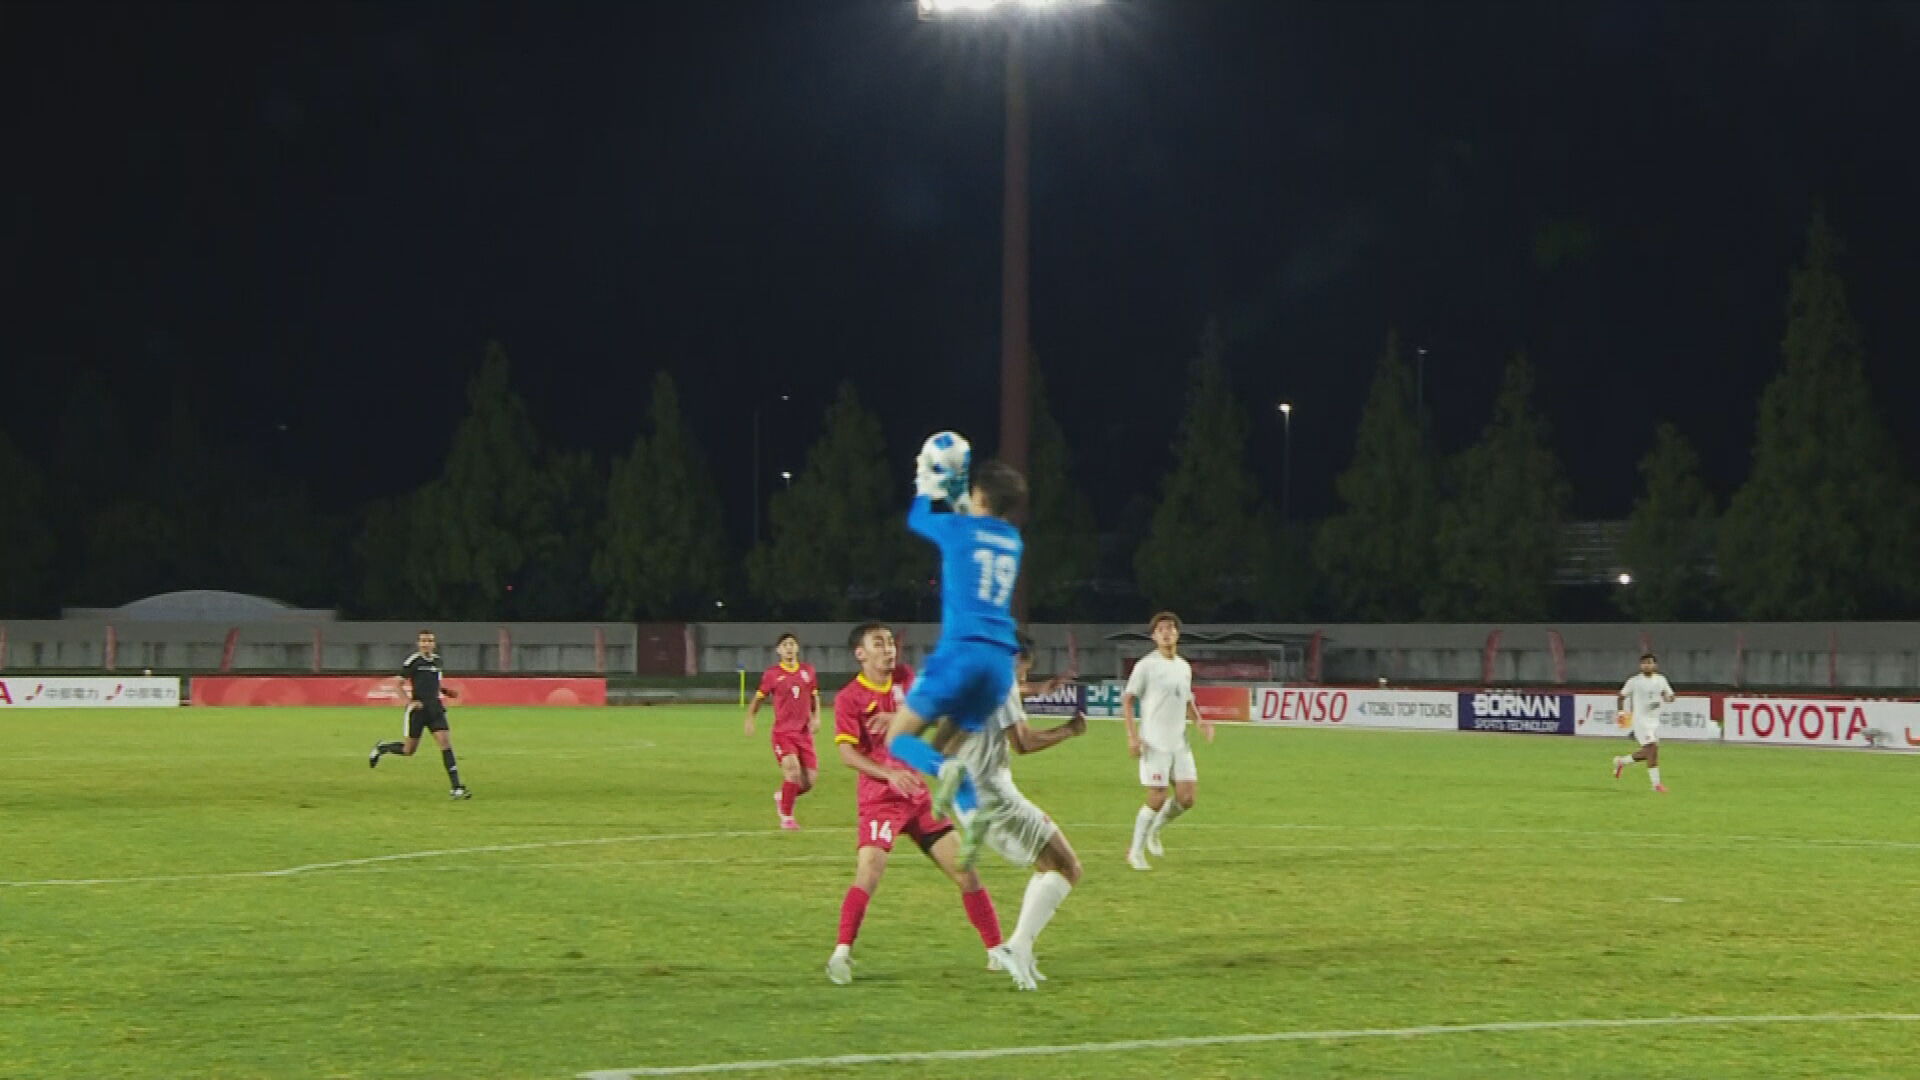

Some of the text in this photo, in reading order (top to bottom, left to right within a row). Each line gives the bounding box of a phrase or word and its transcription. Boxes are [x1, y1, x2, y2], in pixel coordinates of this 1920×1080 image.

[973, 549, 1017, 607] 19
[1262, 690, 1348, 723] DENSO
[1368, 701, 1452, 719] TOBU TOP TOURS
[1472, 693, 1560, 717] BORNAN
[1731, 703, 1870, 741] TOYOTA
[869, 820, 892, 843] 14
